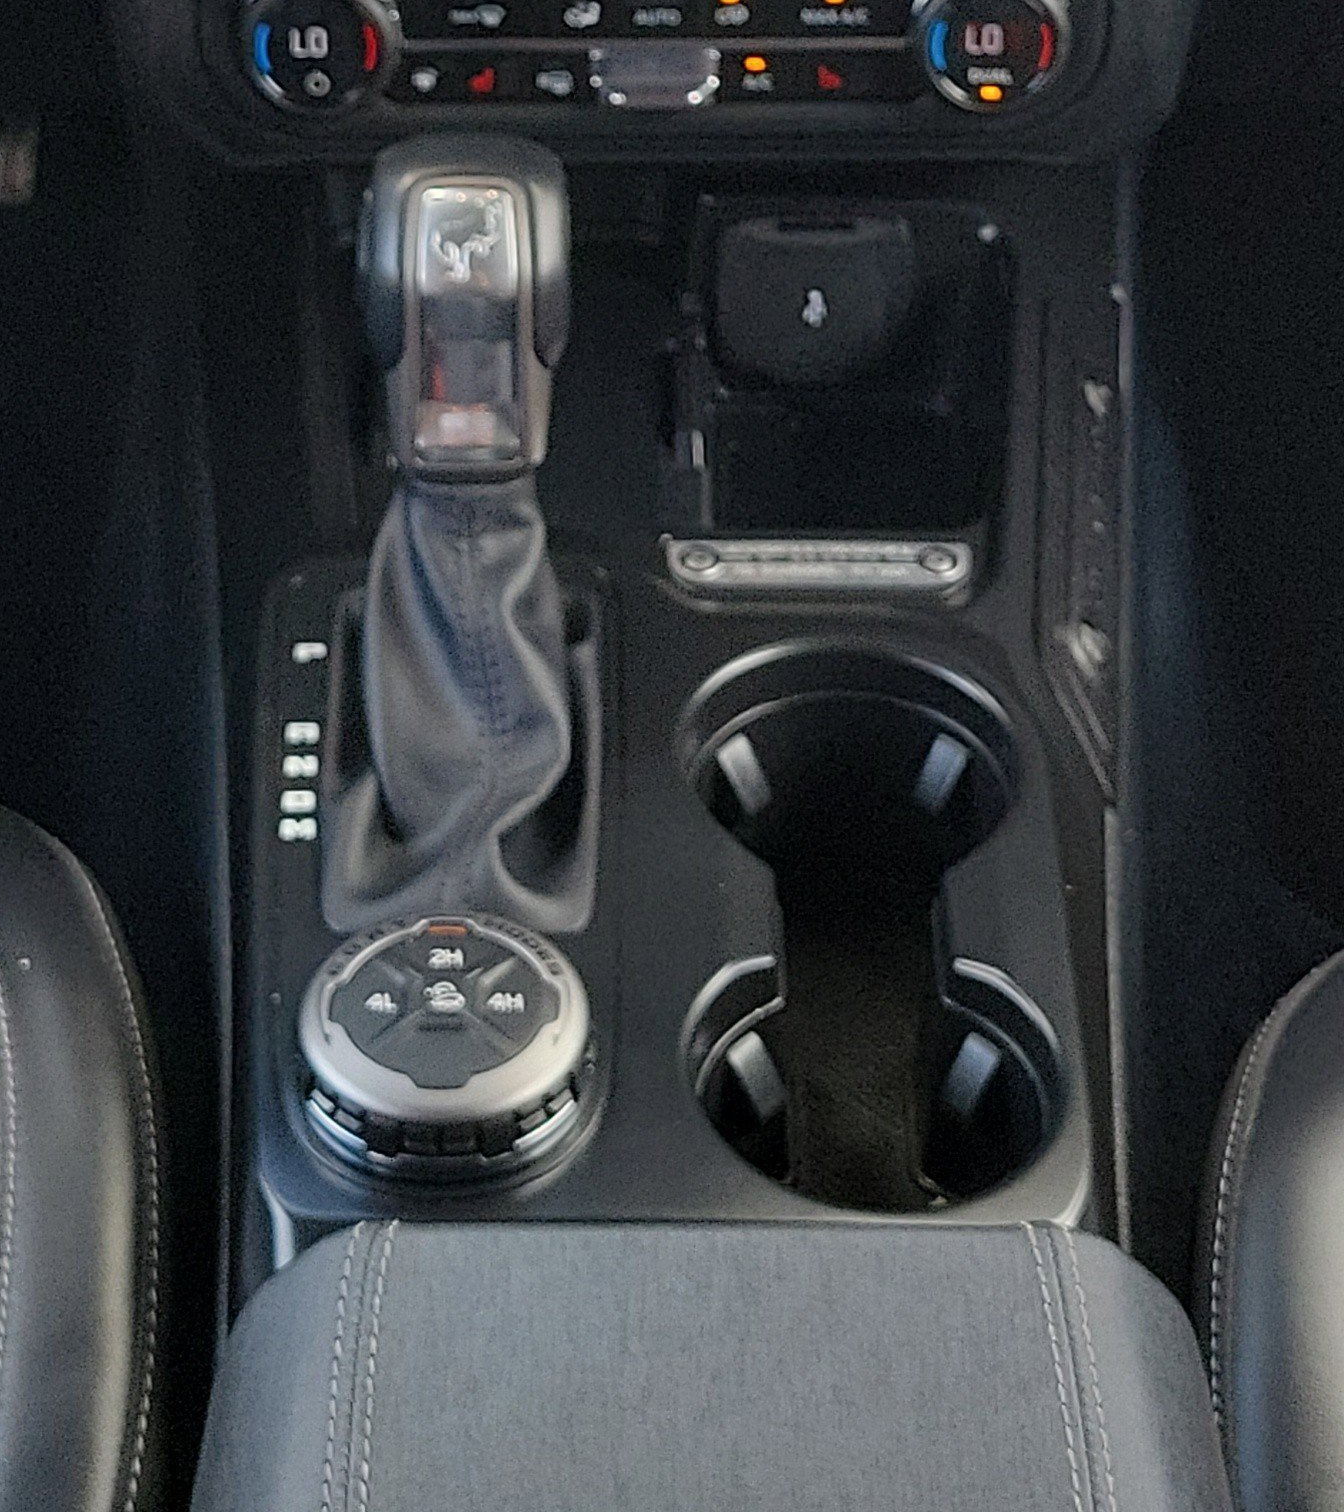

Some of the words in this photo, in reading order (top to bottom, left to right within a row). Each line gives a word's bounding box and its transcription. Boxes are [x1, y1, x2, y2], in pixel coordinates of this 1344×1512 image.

[288, 25, 329, 60] LO
[965, 22, 1005, 56] LO
[282, 753, 320, 779] N
[278, 817, 318, 842] M
[427, 947, 465, 970] 2H
[364, 991, 398, 1015] 4L
[485, 991, 526, 1014] 4H
